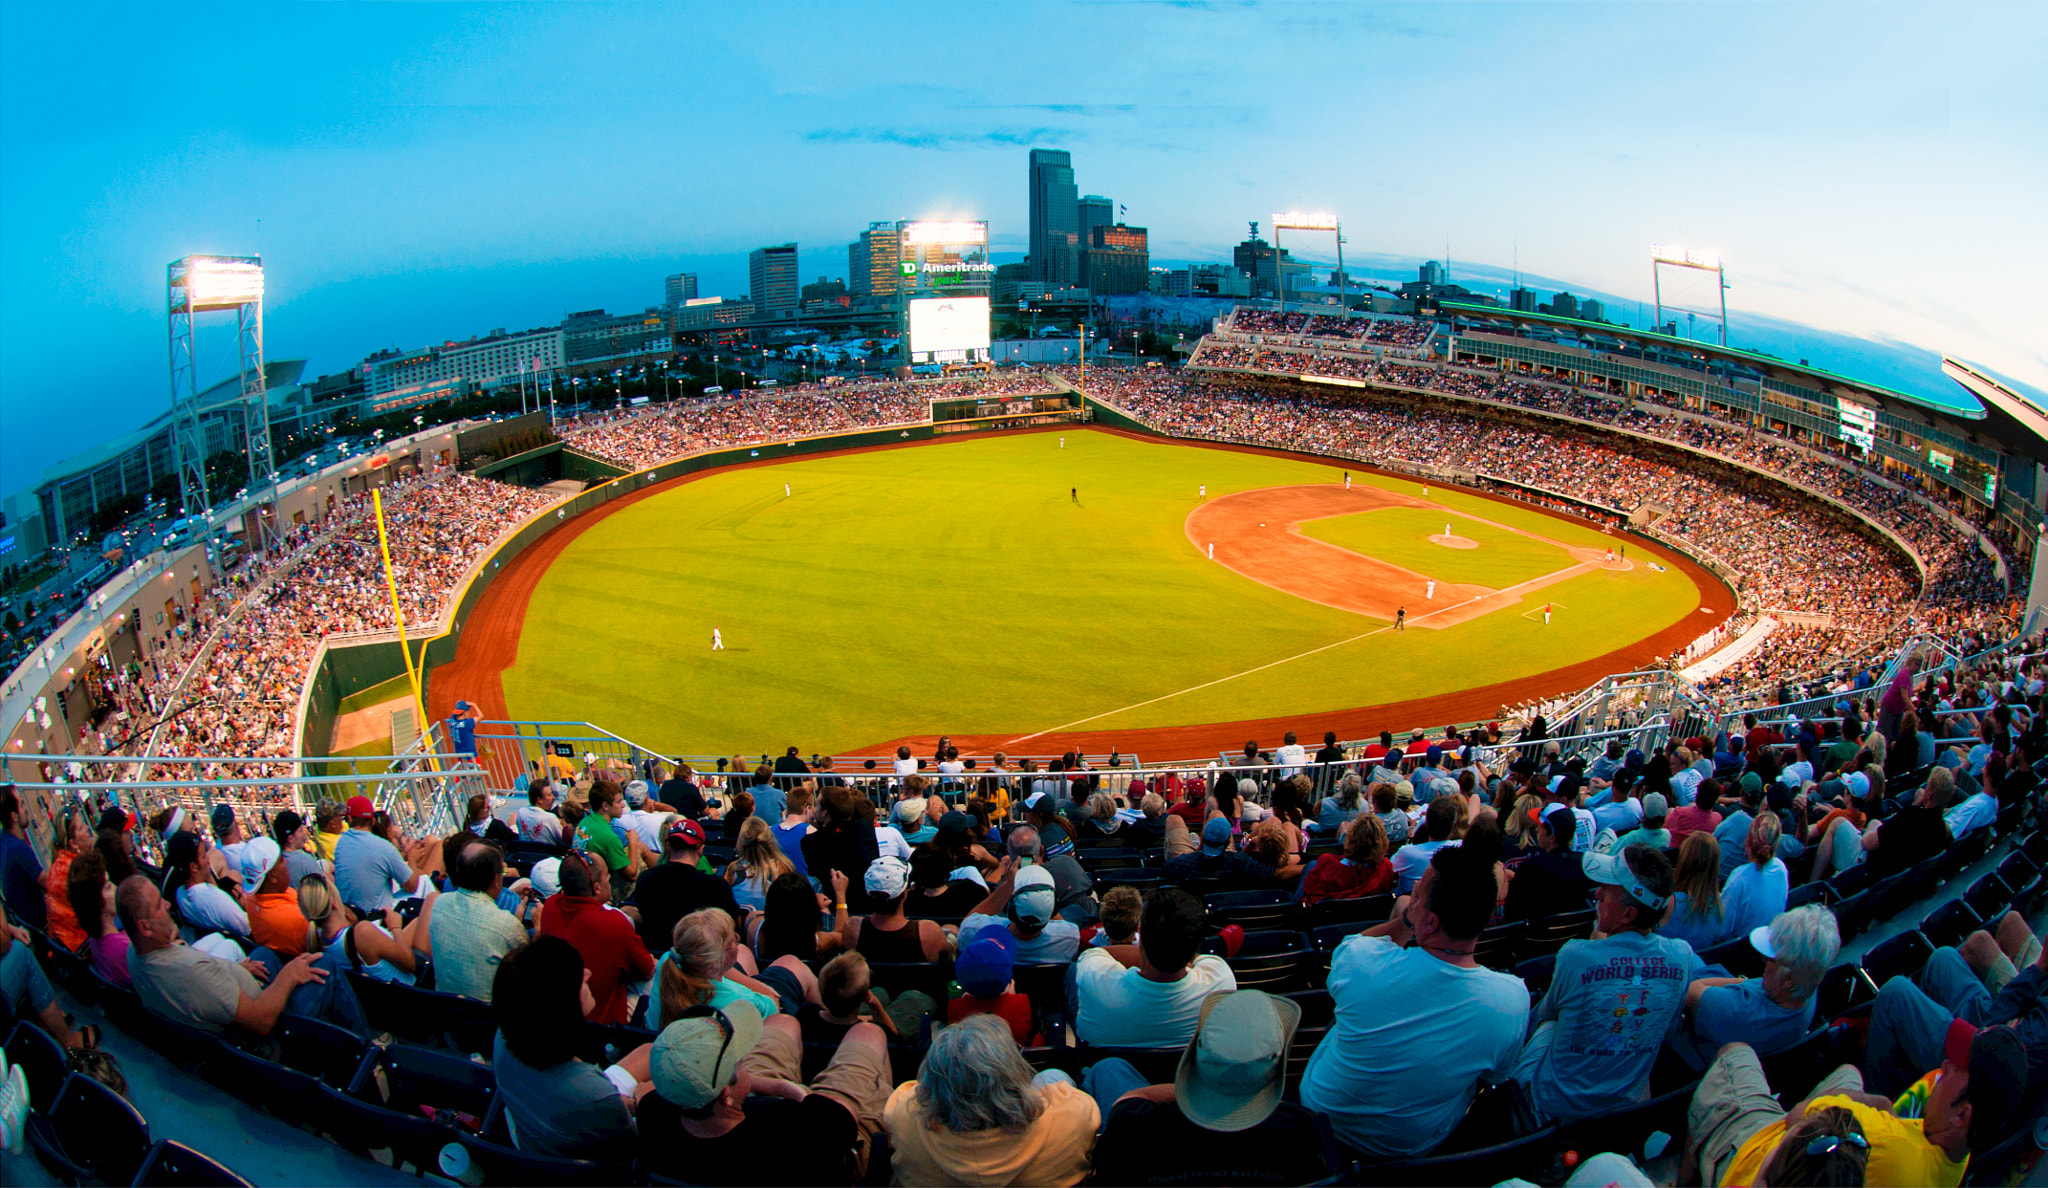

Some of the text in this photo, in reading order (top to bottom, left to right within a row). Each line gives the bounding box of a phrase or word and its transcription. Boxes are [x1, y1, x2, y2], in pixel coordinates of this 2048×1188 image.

[901, 261, 995, 274] TD Ameritrade
[934, 272, 963, 288] park
[678, 821, 687, 830] N
[1610, 956, 1666, 966] COLLEGE
[1581, 965, 1635, 986] WORLD
[1641, 965, 1684, 982] SERIES
